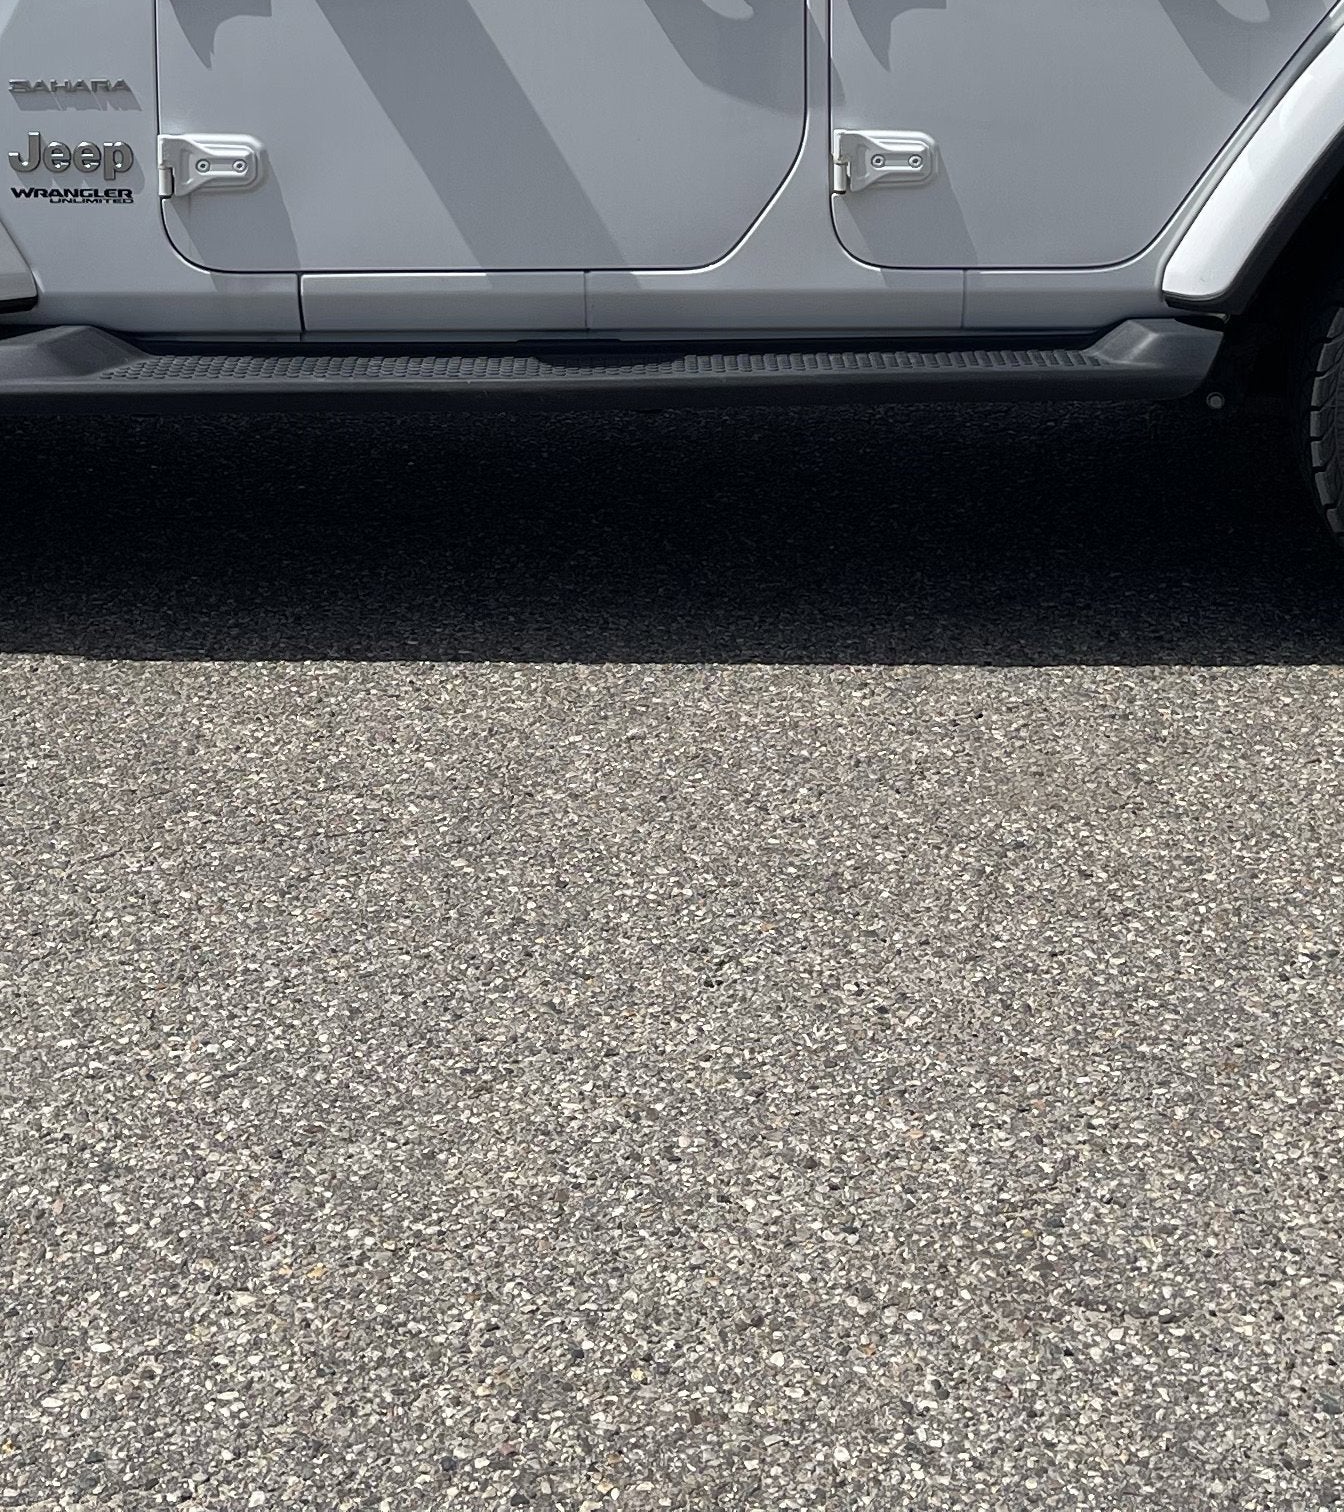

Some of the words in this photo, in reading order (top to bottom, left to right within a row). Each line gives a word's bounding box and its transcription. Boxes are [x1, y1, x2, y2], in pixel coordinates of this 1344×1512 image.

[8, 79, 133, 93] SAHARA
[8, 131, 134, 180] Jeep
[11, 187, 133, 199] WRANGLER
